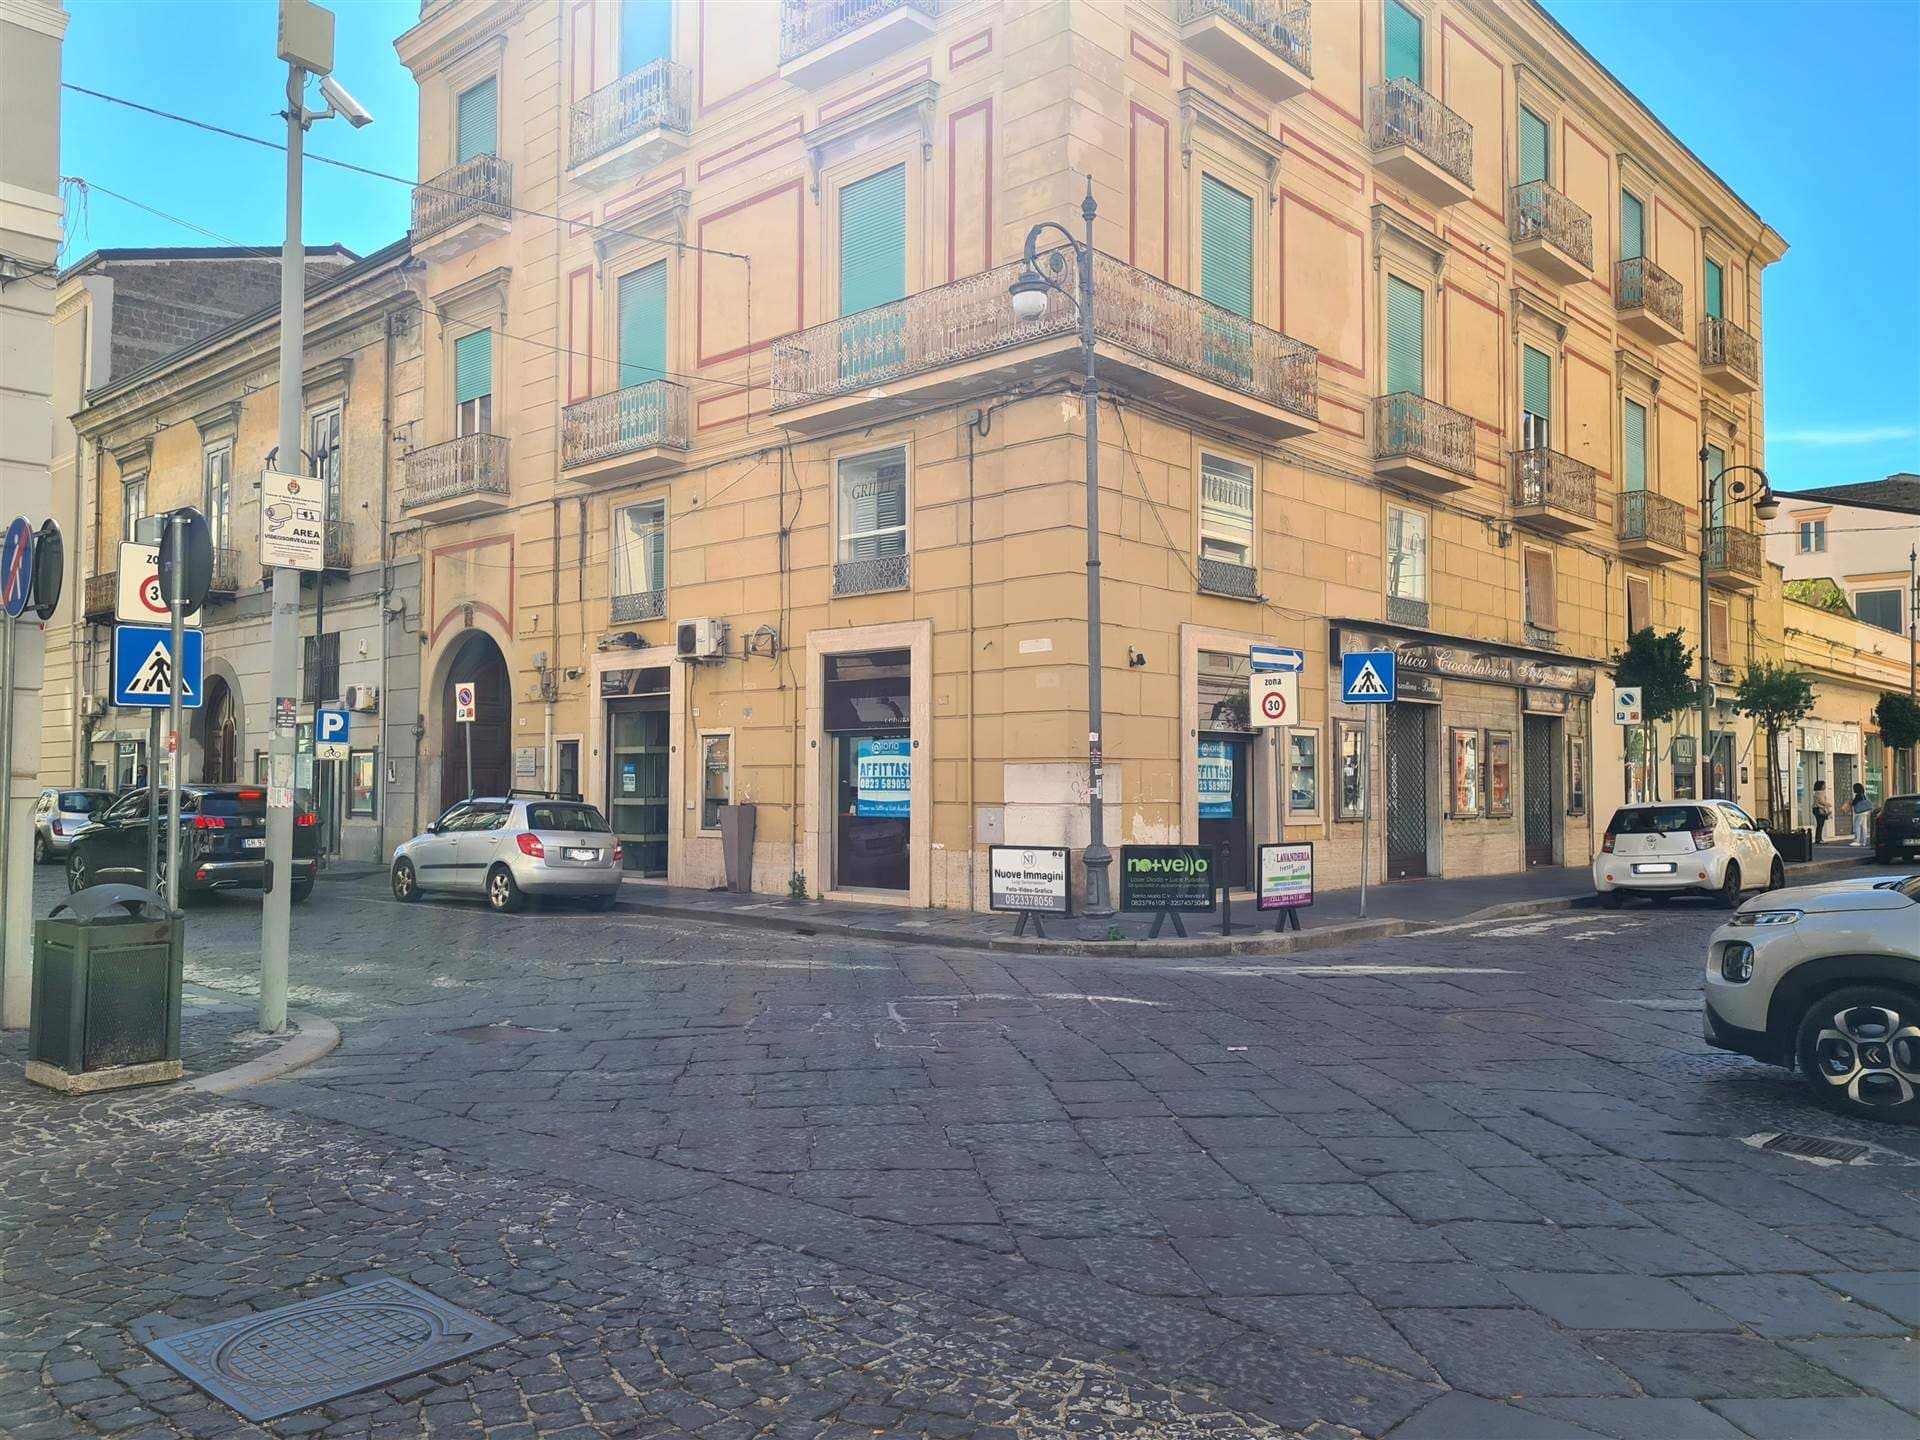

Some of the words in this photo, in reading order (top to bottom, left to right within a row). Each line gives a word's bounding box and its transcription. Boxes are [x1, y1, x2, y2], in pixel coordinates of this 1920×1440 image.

[293, 528, 320, 538] AREA
[264, 533, 321, 546] VIDEOSORVEGLIATA
[1264, 678, 1282, 686] zona
[1267, 700, 1280, 711] 30
[322, 712, 344, 740] P
[860, 762, 911, 777] AFFITTASI
[860, 778, 879, 789] 0823
[1276, 851, 1310, 863] LAVANDERIA
[994, 869, 1022, 879] Nuove
[1023, 870, 1064, 883] Immagini
[1005, 894, 1054, 906] 0823378056
